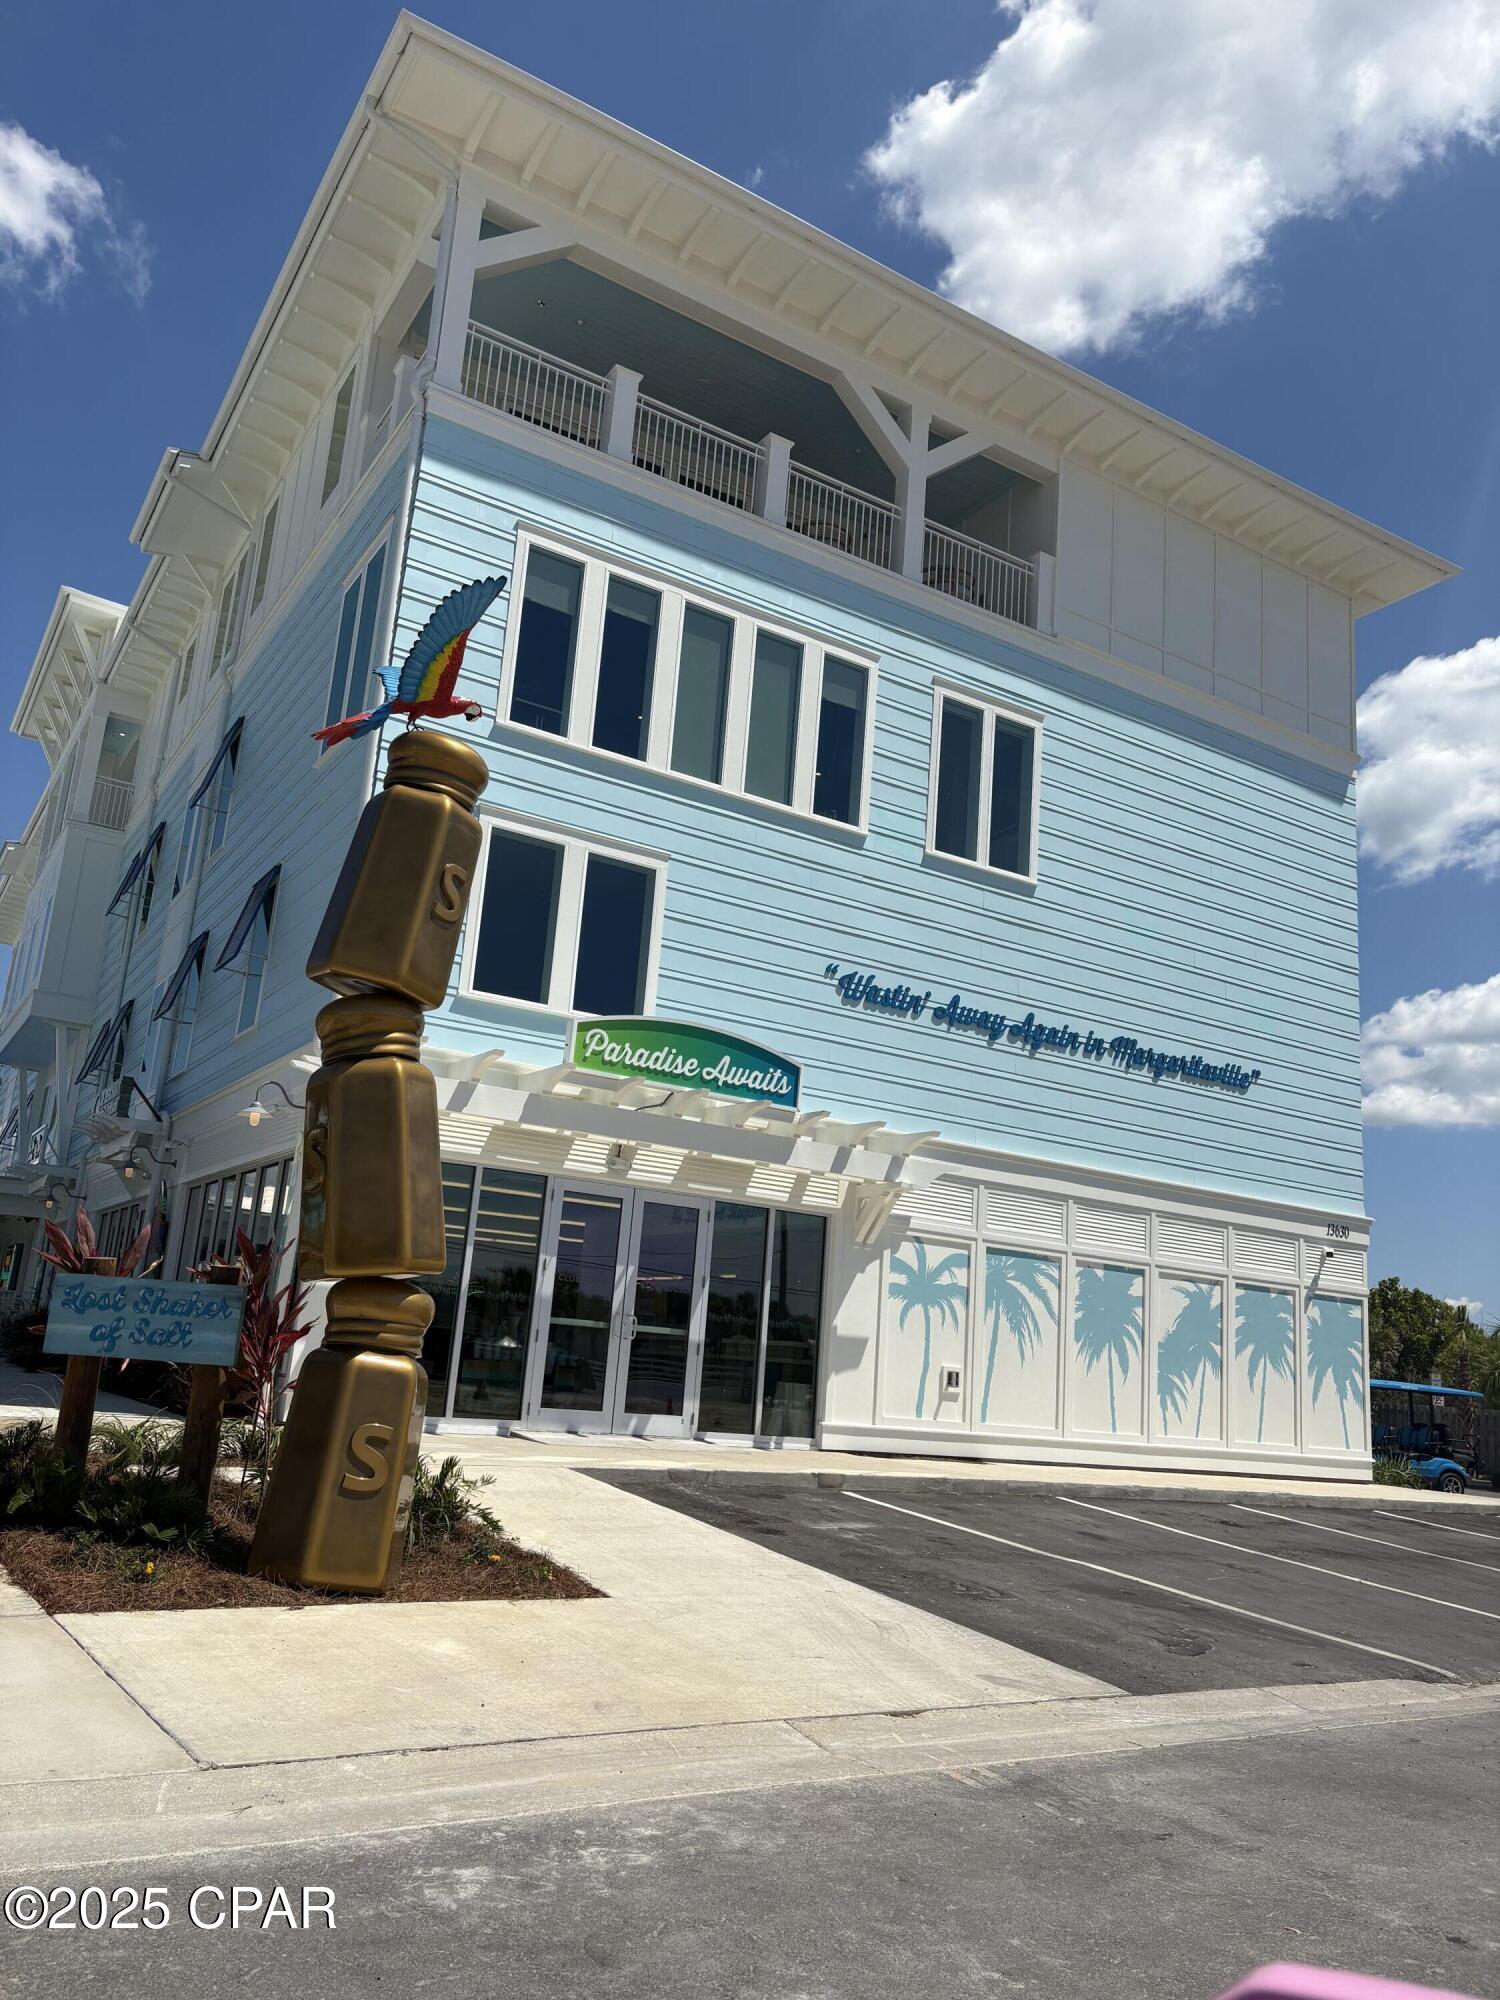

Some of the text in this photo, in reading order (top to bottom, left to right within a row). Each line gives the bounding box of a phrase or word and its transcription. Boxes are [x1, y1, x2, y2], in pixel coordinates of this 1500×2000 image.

[433, 863, 468, 922] S
[934, 994, 1008, 1041] Away
[1009, 1012, 1082, 1050] Again
[1083, 1030, 1107, 1057] in
[585, 1028, 793, 1095] Paradise Awaits
[1326, 1223, 1350, 1239] 13630
[61, 1282, 232, 1320] Lost Shaker
[89, 1316, 193, 1353] of Salt
[340, 1422, 394, 1493] S
